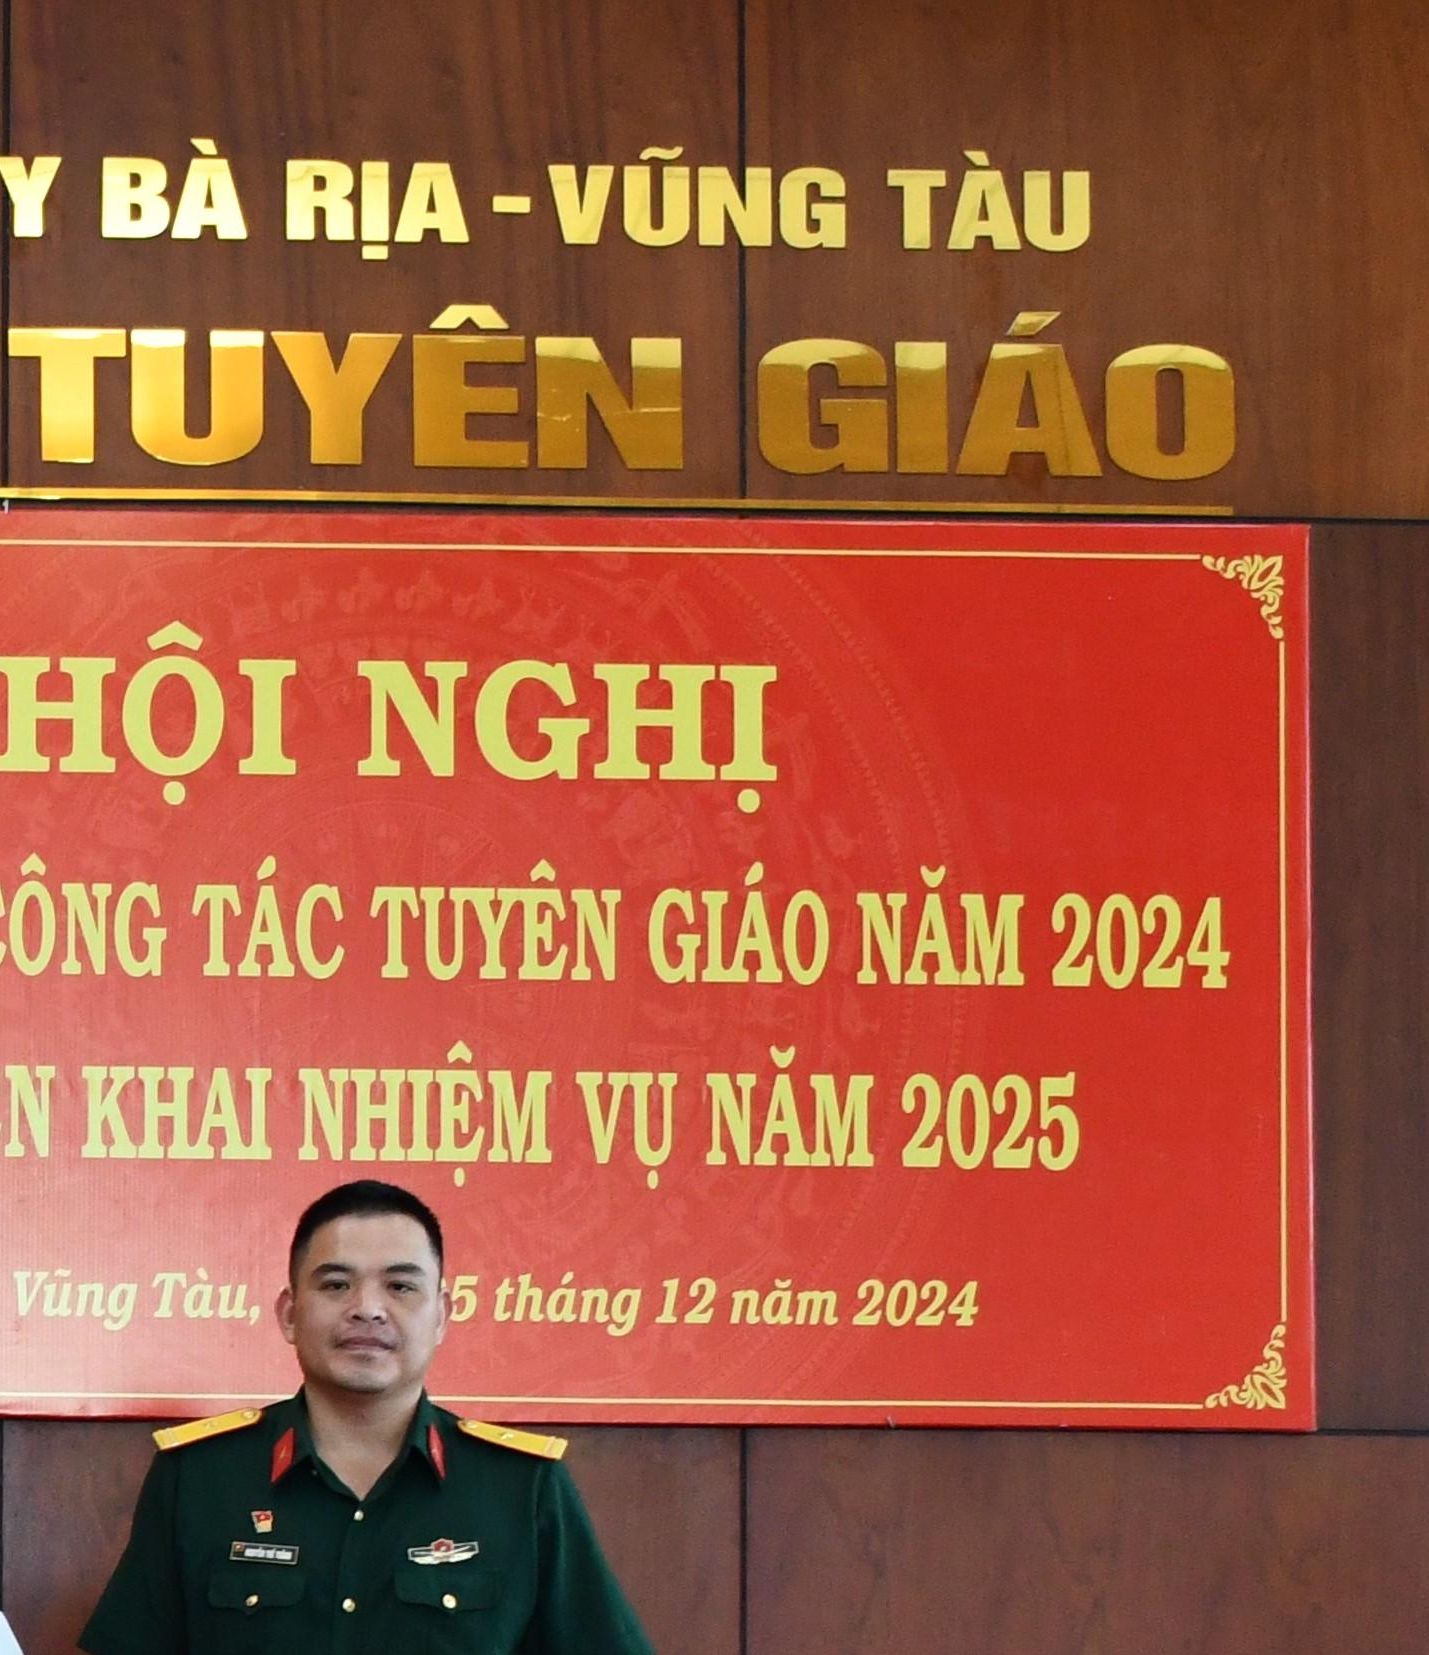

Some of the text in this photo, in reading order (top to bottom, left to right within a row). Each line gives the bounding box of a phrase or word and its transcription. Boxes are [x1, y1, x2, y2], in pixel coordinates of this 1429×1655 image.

[101, 137, 248, 240] BÀ
[285, 158, 470, 260] RỊA
[492, 195, 531, 213] -
[547, 146, 847, 248] VŨNG
[887, 150, 1091, 252] TÀU
[7, 302, 684, 469] TUYÊN
[756, 310, 1236, 481] GIÁO
[357, 659, 778, 813] NGHỊ
[191, 855, 345, 980] TÁC
[370, 859, 622, 981] TUYÊN
[648, 860, 830, 986] GIÁO
[856, 864, 1025, 986] NĂM
[1051, 893, 1231, 989] 2024
[80, 1066, 273, 1160] KHAI
[297, 1040, 553, 1188] NHIỆM
[575, 1071, 678, 1190] VỤ
[706, 1045, 875, 1167] NĂM
[901, 1071, 1080, 1171] 2025
[12, 1268, 139, 1332] Vũng
[151, 1268, 262, 1325] Tàu,
[441, 1274, 479, 1323] 5
[493, 1271, 642, 1337] tháng
[655, 1277, 718, 1324] 12
[730, 1279, 839, 1327] năm
[852, 1279, 980, 1328] 2024
